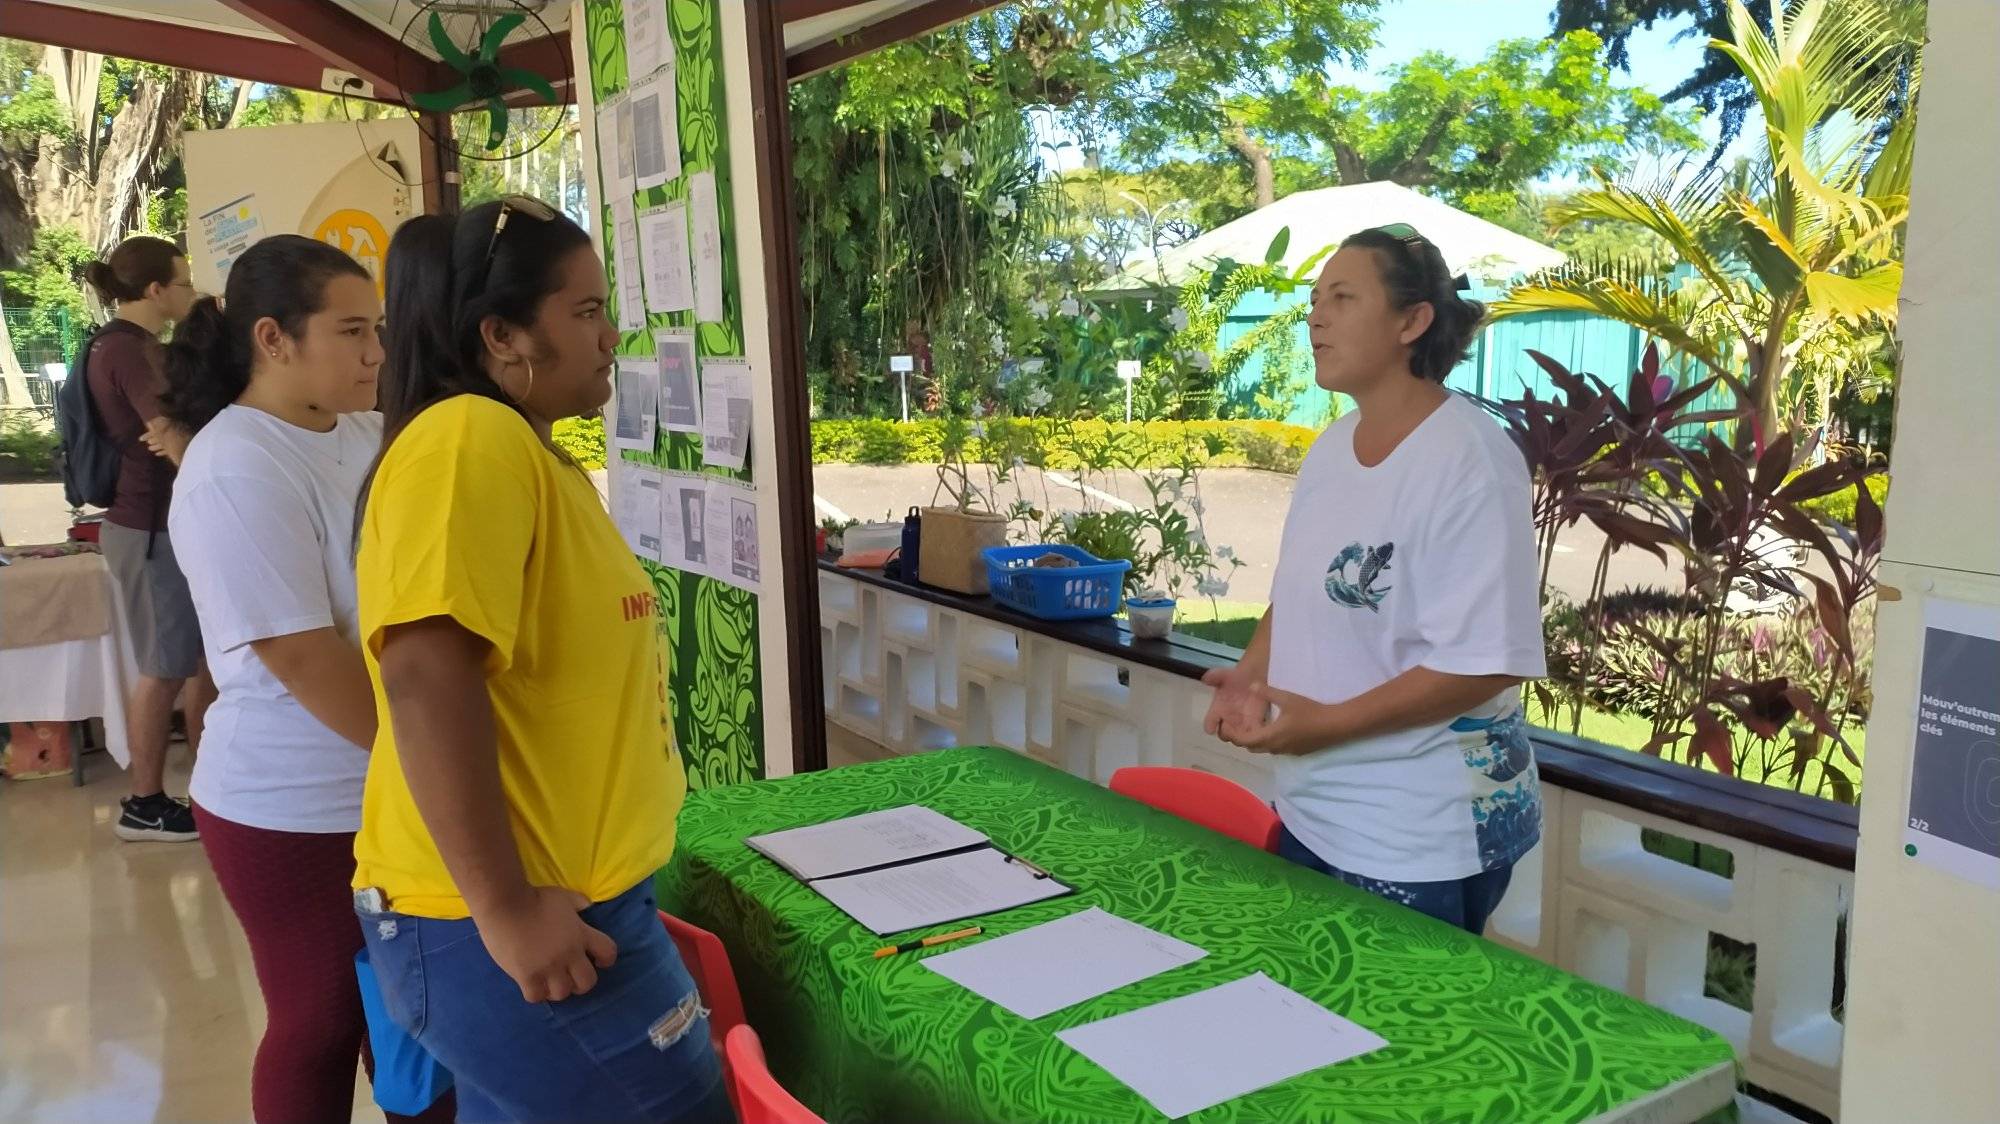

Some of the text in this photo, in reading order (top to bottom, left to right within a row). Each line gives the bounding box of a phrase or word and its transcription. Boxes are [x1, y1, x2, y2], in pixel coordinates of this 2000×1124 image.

[1921, 707, 1996, 736] les éléments
[1920, 723, 1943, 736] clés
[1910, 818, 1929, 832] 2/2
